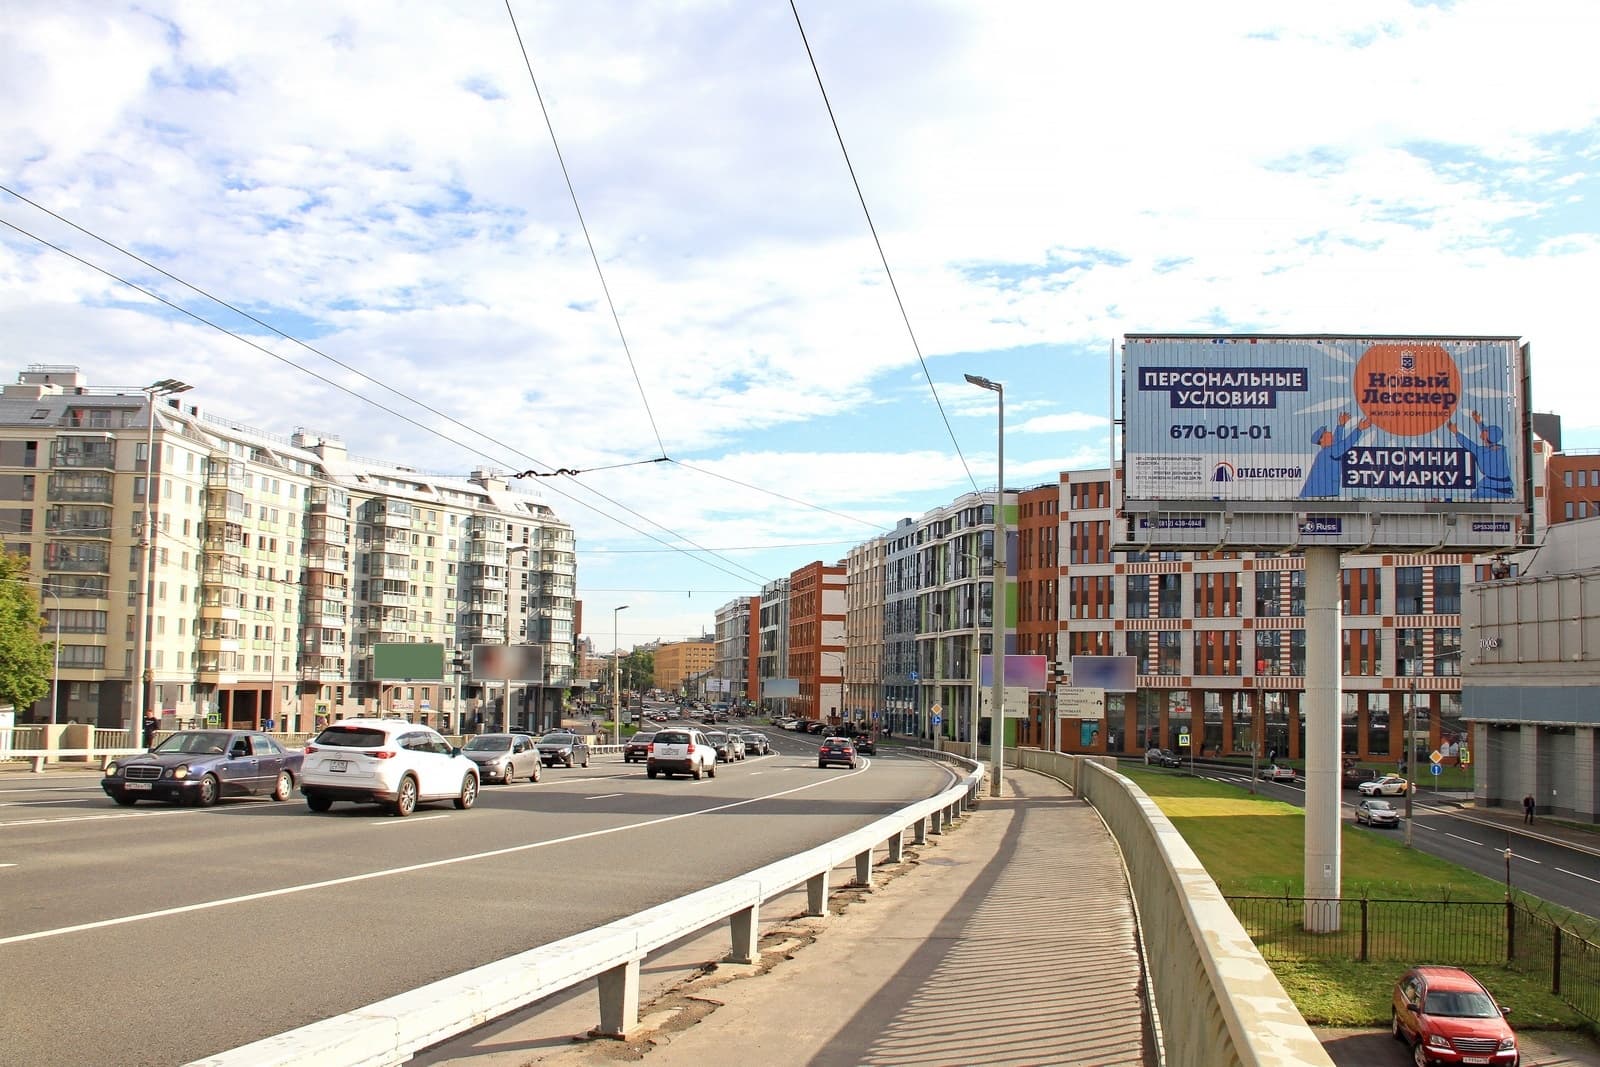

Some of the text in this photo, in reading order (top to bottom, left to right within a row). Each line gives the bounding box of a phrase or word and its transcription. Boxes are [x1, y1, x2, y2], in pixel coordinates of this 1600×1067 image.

[1144, 372, 1302, 387] ПЕРСОНАЛЬНЫЕ
[1368, 371, 1450, 388] Новый
[1178, 391, 1269, 405] УСЛОВИЯ
[1361, 389, 1457, 409] Лесснер
[1170, 425, 1272, 440] 670-01-01
[1347, 450, 1458, 466] ЗАПОМНИ
[1237, 466, 1302, 479] ОТДЕЛСТРОЙ
[1347, 470, 1388, 485] ЭТУ
[1389, 470, 1458, 486] МАРКУ
[1316, 522, 1337, 531] Russ
